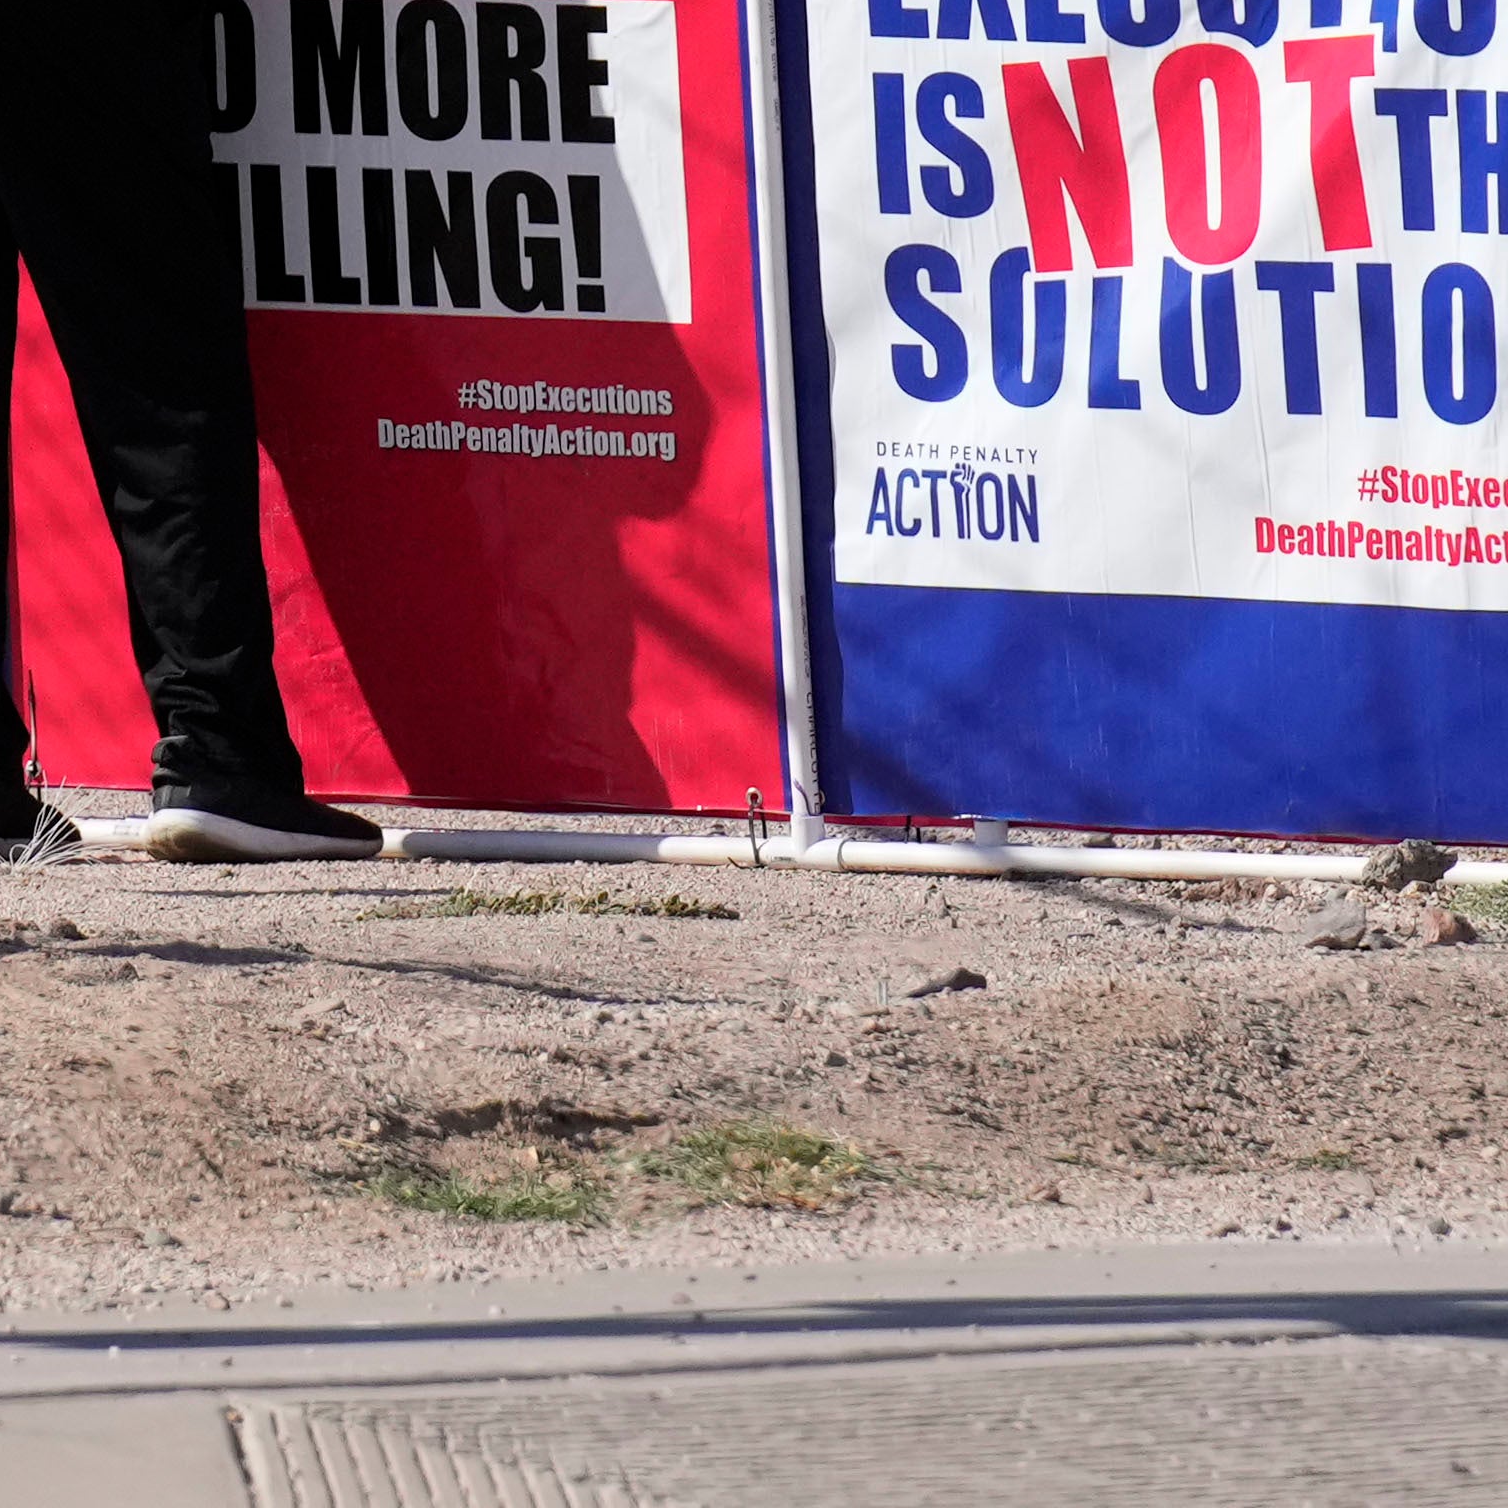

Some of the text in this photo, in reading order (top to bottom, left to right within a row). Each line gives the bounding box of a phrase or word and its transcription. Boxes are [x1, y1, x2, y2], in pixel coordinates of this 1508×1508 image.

[873, 72, 995, 219] IS
[1002, 34, 1376, 274] NOT
[212, 161, 606, 314] LLING!
[458, 379, 673, 415] #StopExecutions
[378, 419, 676, 462] DeathPenaltyAction.org
[876, 441, 1038, 465] DEATH PENALTY
